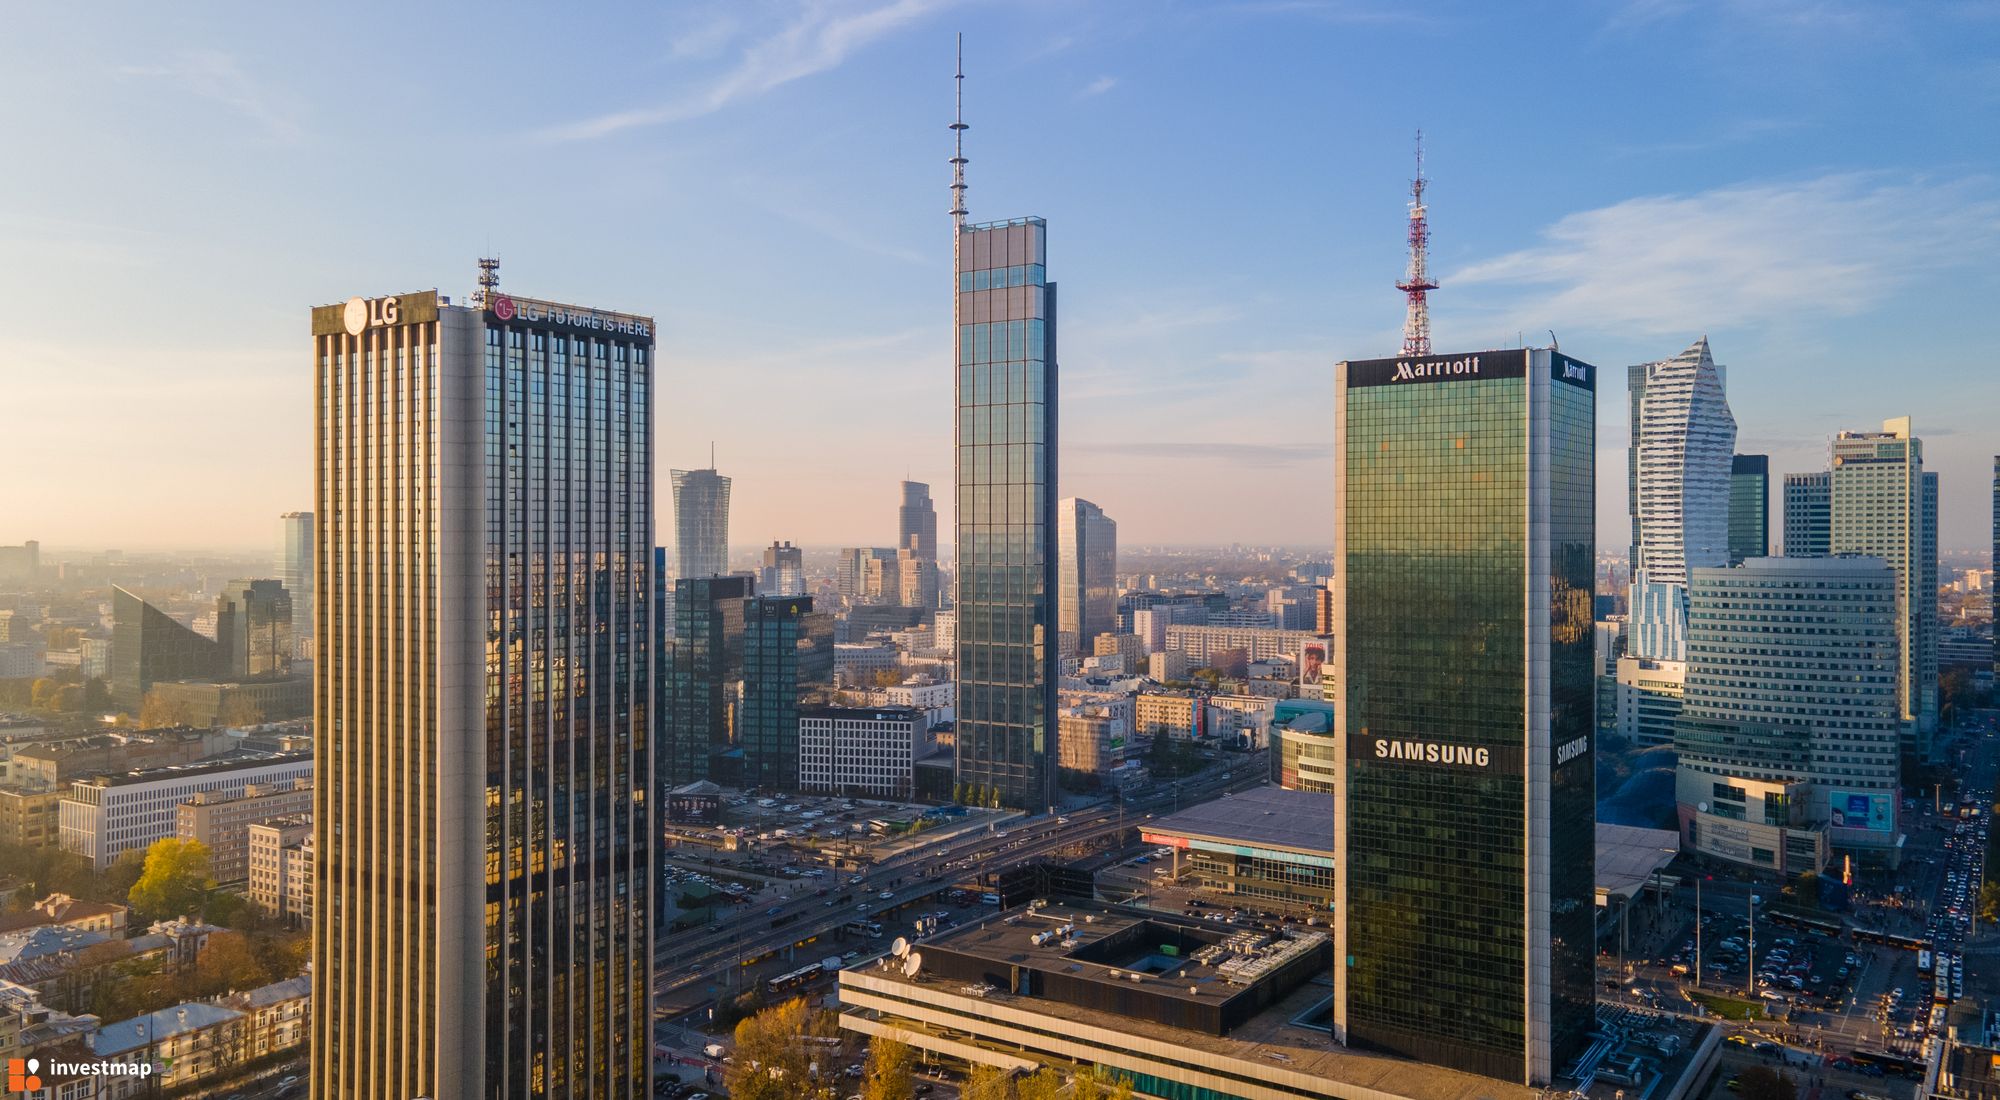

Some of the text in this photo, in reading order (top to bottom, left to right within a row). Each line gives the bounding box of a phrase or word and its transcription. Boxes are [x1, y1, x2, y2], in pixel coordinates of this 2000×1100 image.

[371, 297, 398, 326] LG
[516, 303, 650, 337] LG FUTURE IS HERE
[1391, 356, 1480, 382] Marriott
[1562, 360, 1587, 382] Marriott
[1375, 739, 1490, 767] SAMSUNG
[1557, 735, 1588, 765] SAMSUNG
